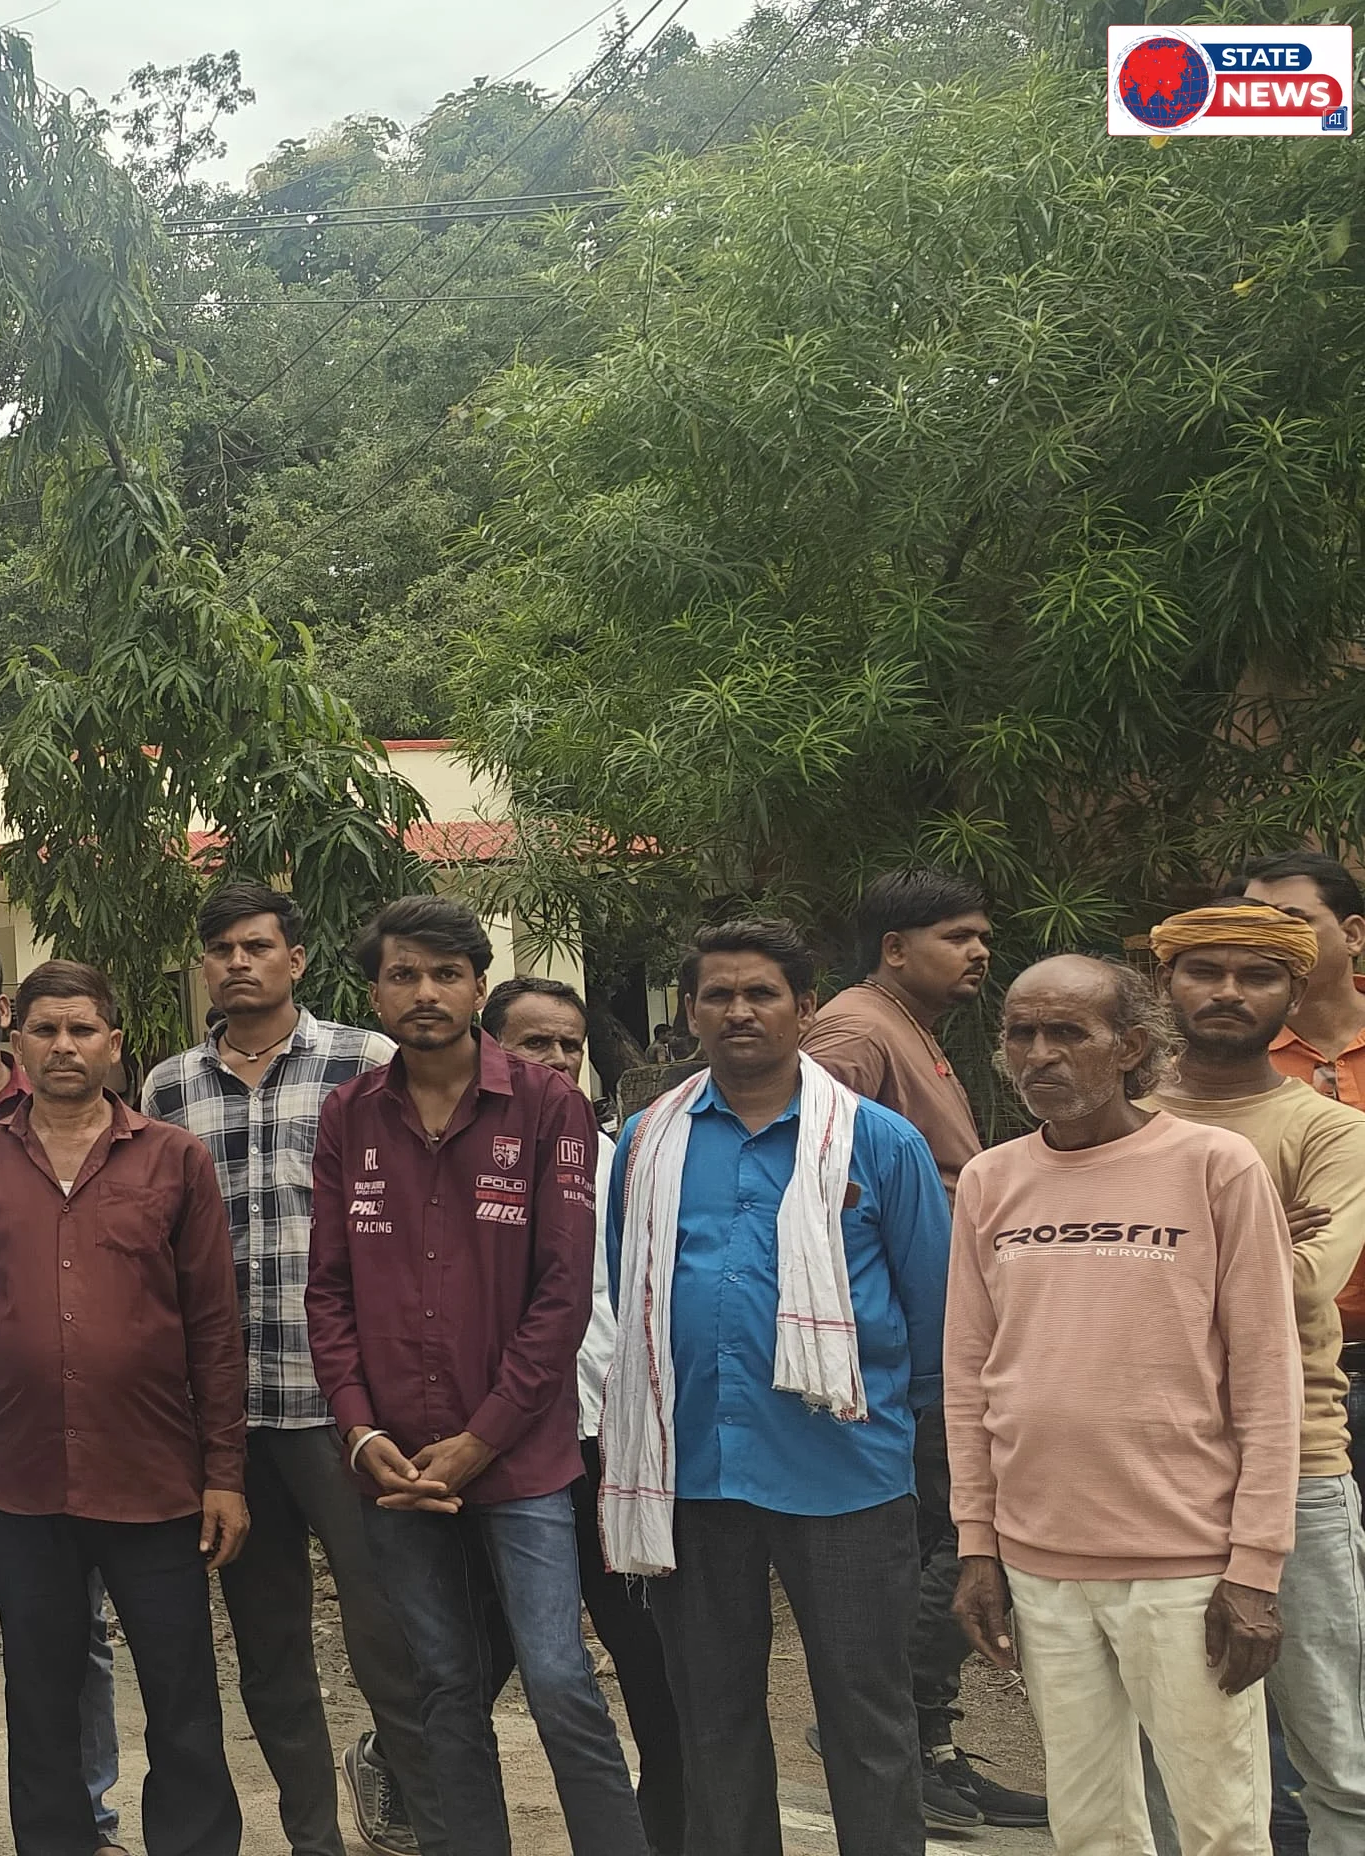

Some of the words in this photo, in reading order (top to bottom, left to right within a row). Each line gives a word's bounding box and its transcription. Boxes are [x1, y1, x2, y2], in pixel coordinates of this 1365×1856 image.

[364, 1148, 379, 1171] RL
[561, 1140, 585, 1166] 067
[480, 1177, 523, 1190] POLO
[356, 1221, 392, 1234] RACING
[993, 1222, 1190, 1251] CROSSFIT
